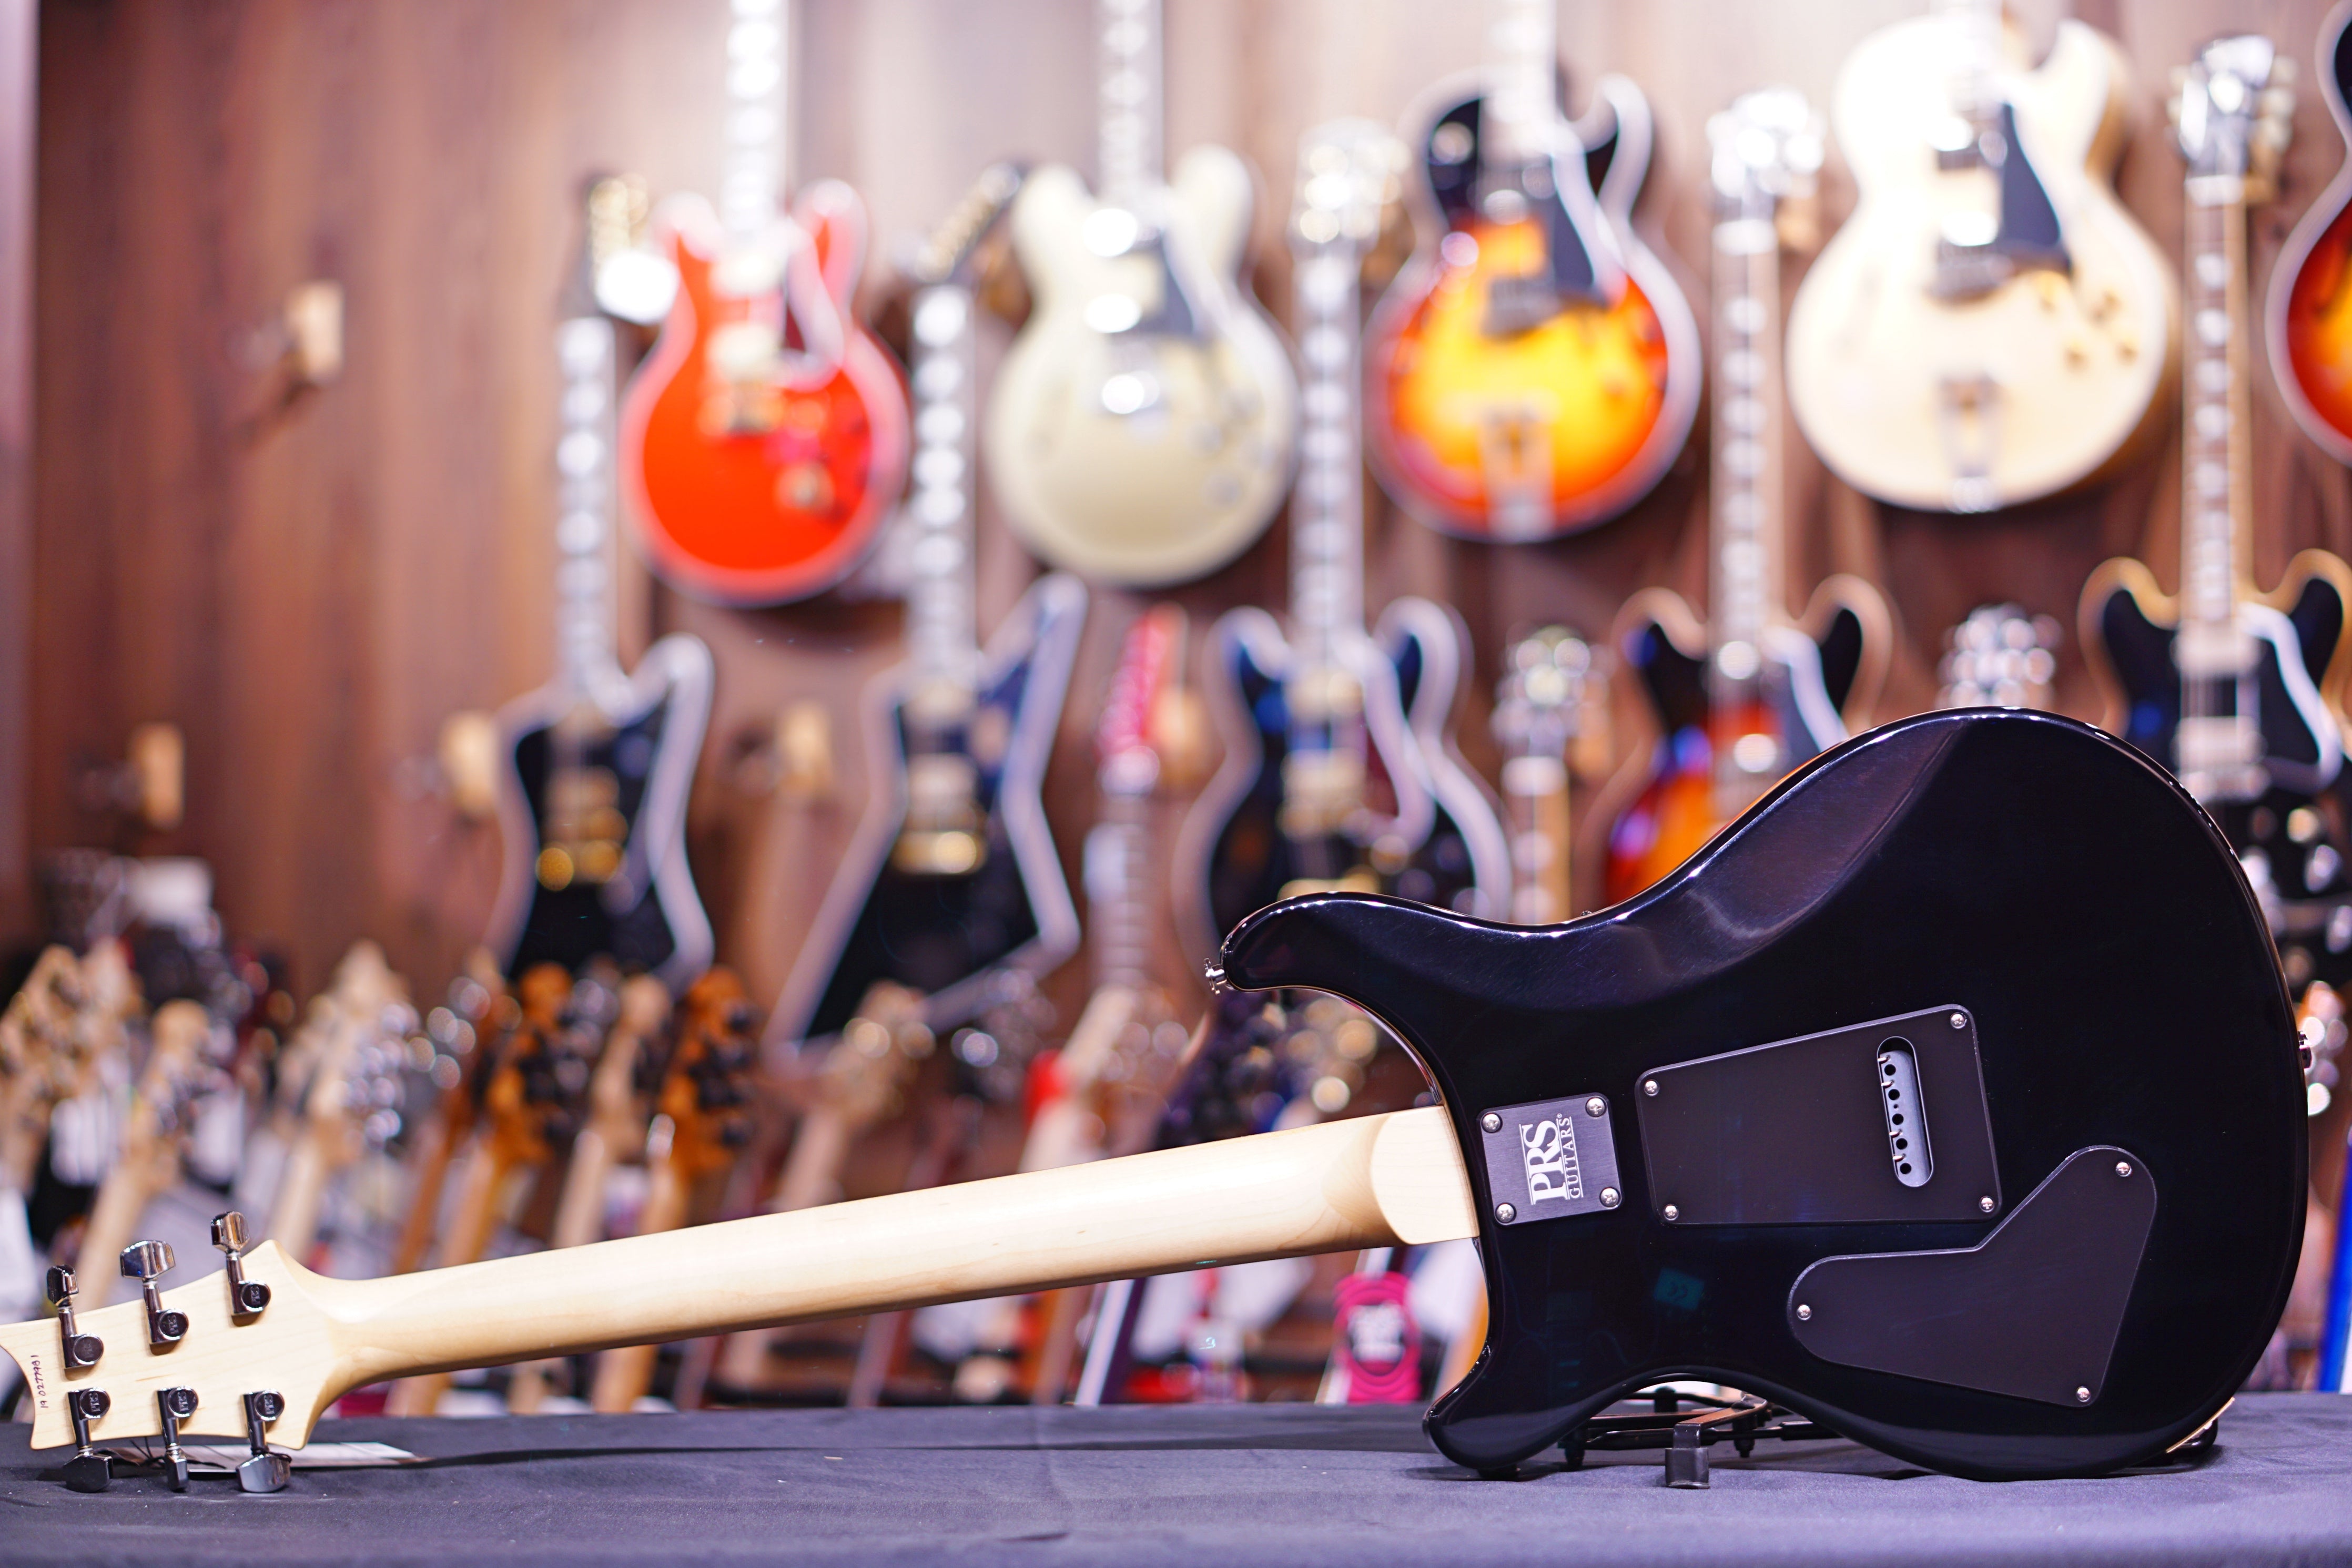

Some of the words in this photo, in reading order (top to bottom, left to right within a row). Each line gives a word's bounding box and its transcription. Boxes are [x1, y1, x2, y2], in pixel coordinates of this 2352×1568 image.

[1521, 1120, 1569, 1205] PRS
[89, 1392, 101, 1412] PRS
[178, 1391, 189, 1412] PRS
[264, 1394, 276, 1414] PRS
